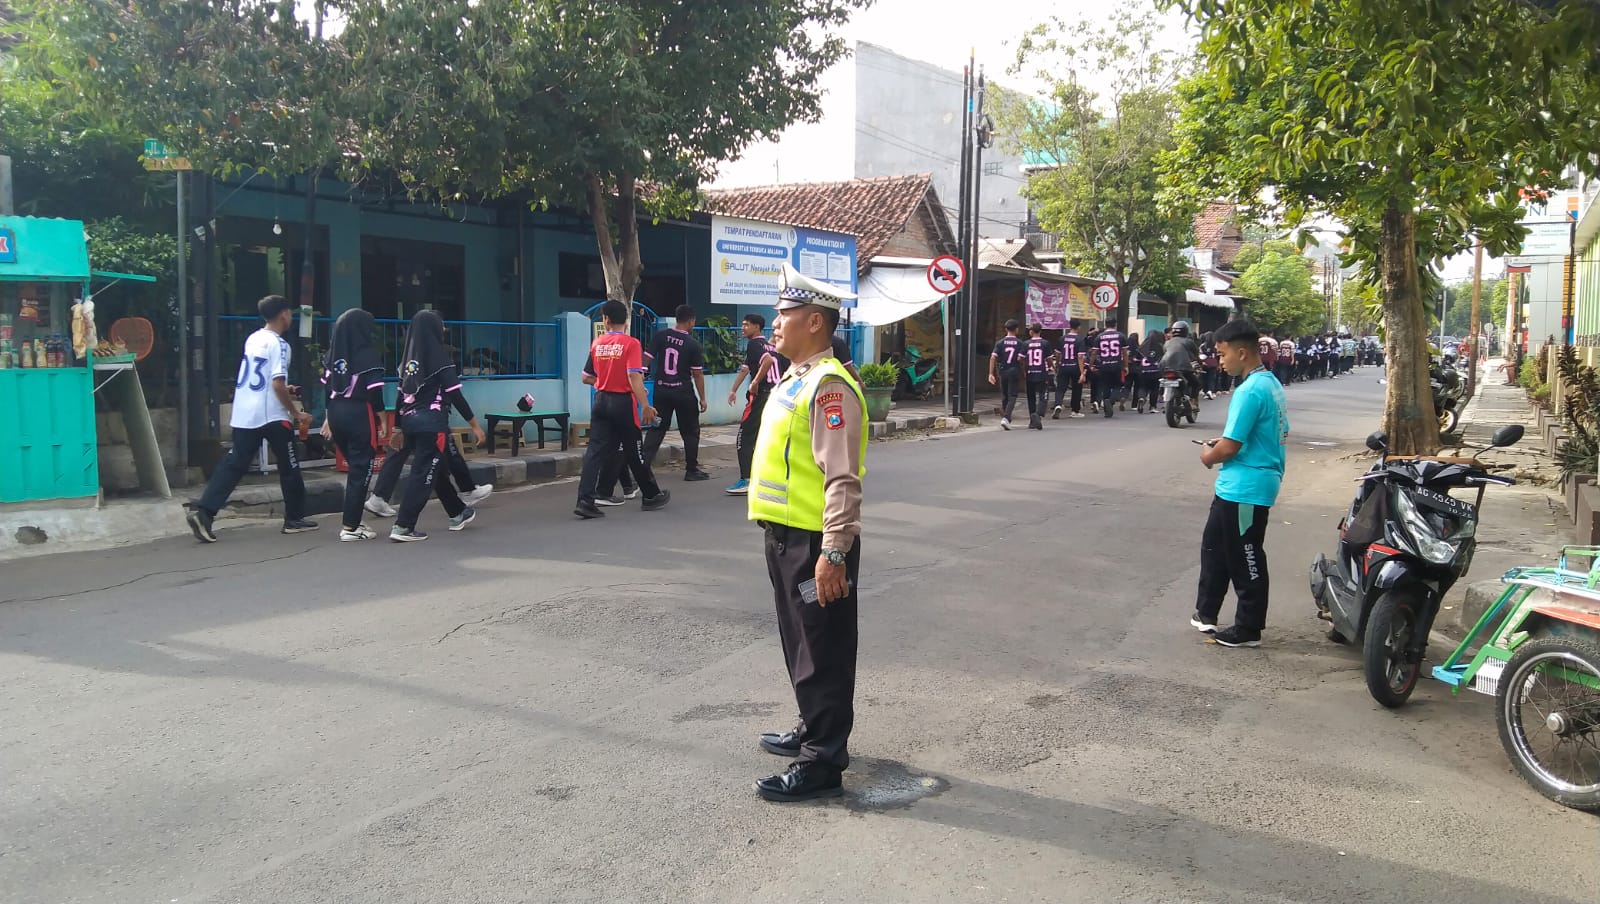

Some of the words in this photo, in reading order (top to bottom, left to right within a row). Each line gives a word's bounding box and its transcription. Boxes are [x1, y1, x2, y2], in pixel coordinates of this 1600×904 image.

[724, 226, 745, 236] TEMPAT
[745, 228, 782, 240] PENDAFTARAN
[725, 262, 749, 271] SALUT
[1095, 291, 1110, 304] 50
[667, 335, 684, 346] TYTO
[1100, 340, 1120, 357] 55
[1004, 346, 1016, 364] 7
[1028, 349, 1043, 366] 19
[1063, 343, 1075, 360] 11
[664, 347, 679, 375] 0
[1417, 487, 1429, 497] AG
[1460, 502, 1473, 512] VK
[1244, 543, 1260, 580] SMASA
